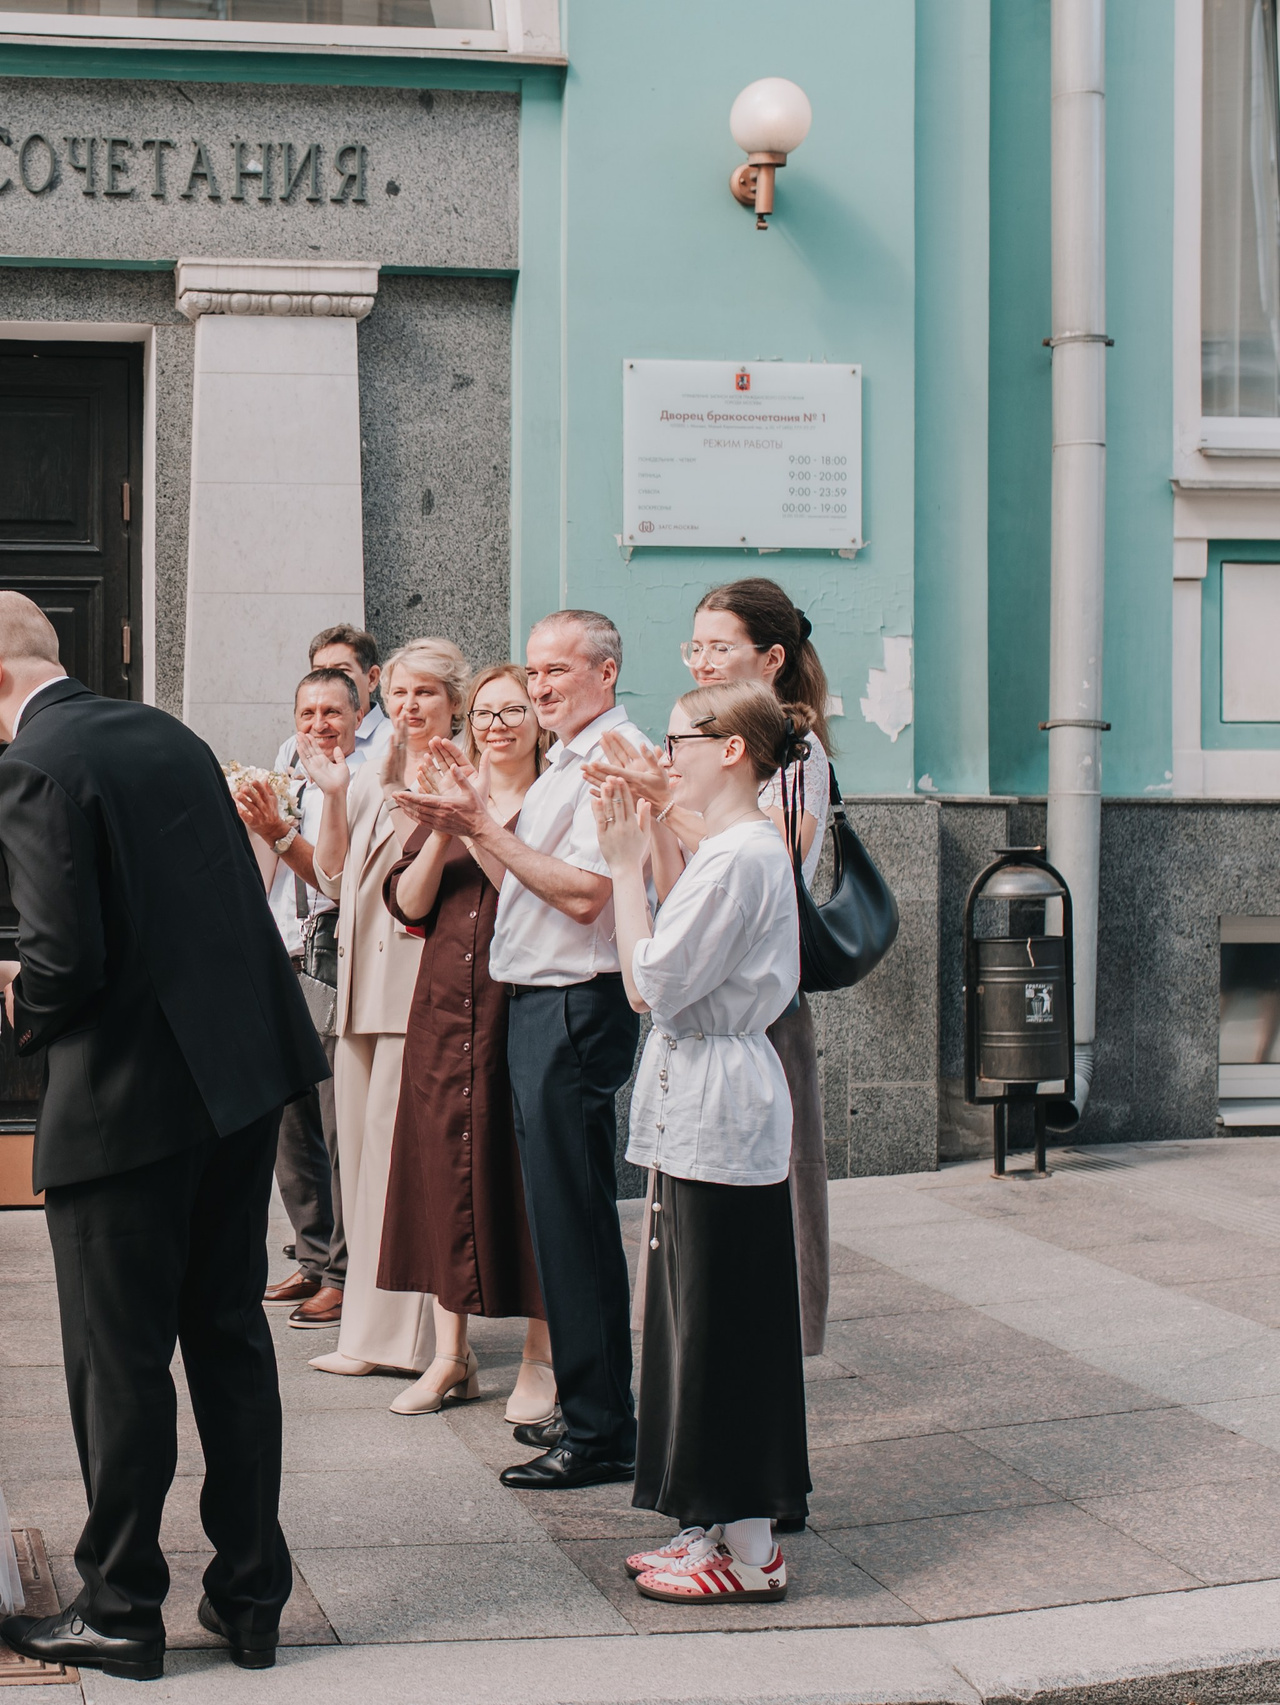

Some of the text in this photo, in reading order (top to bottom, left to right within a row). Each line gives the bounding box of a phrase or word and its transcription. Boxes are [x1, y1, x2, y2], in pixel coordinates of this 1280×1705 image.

[660, 410, 704, 422] Дворец
[707, 411, 800, 423] бракосочетания
[821, 413, 826, 423] 1
[703, 439, 783, 449] РЕЖИМ РАБОТЫ
[788, 455, 811, 465] 9:00
[821, 455, 847, 465] 18:00
[788, 471, 811, 481] 9:00
[819, 471, 847, 481] 20:00
[788, 487, 811, 497] 9:00
[819, 487, 847, 497] 23:59
[782, 503, 811, 513] 00:00
[821, 503, 847, 513] 19:00
